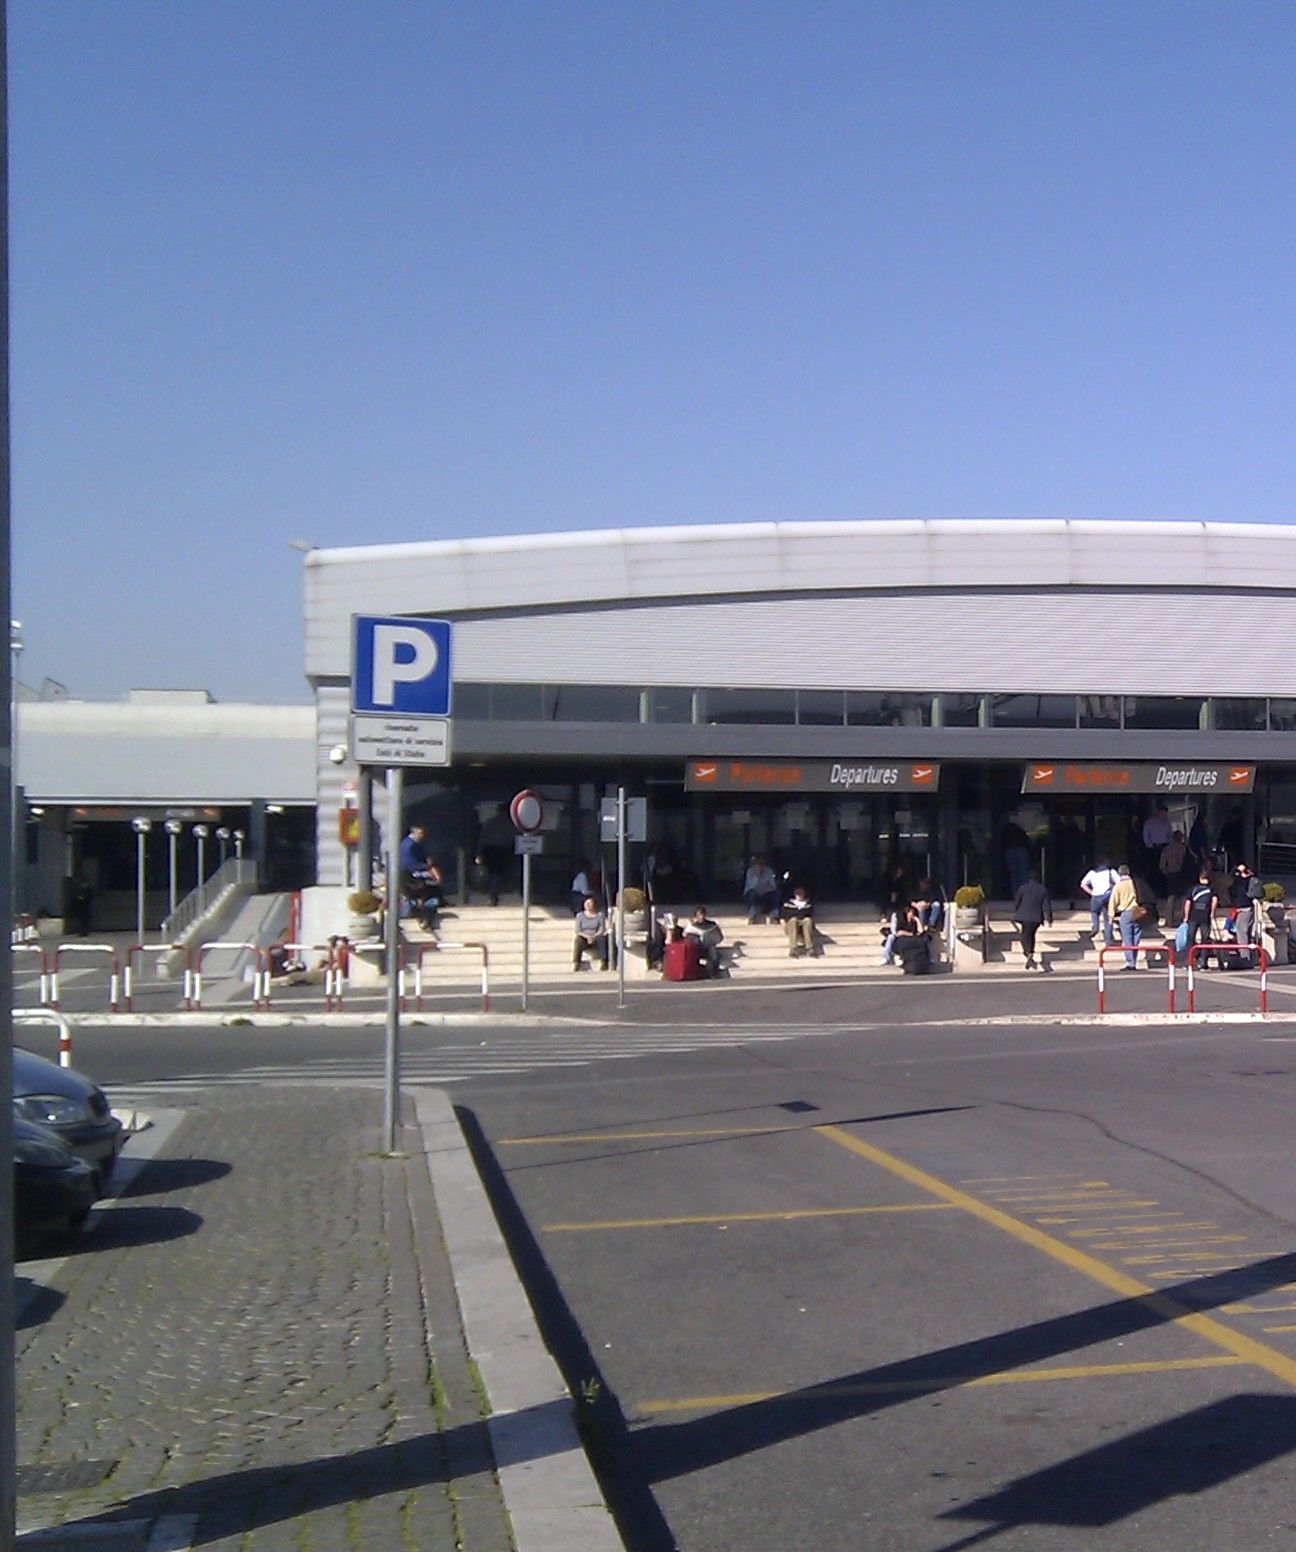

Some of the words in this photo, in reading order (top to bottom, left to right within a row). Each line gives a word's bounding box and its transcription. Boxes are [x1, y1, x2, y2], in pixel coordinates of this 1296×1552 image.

[373, 625, 437, 704] P
[830, 763, 898, 788] Departures
[1156, 766, 1218, 790] Departures
